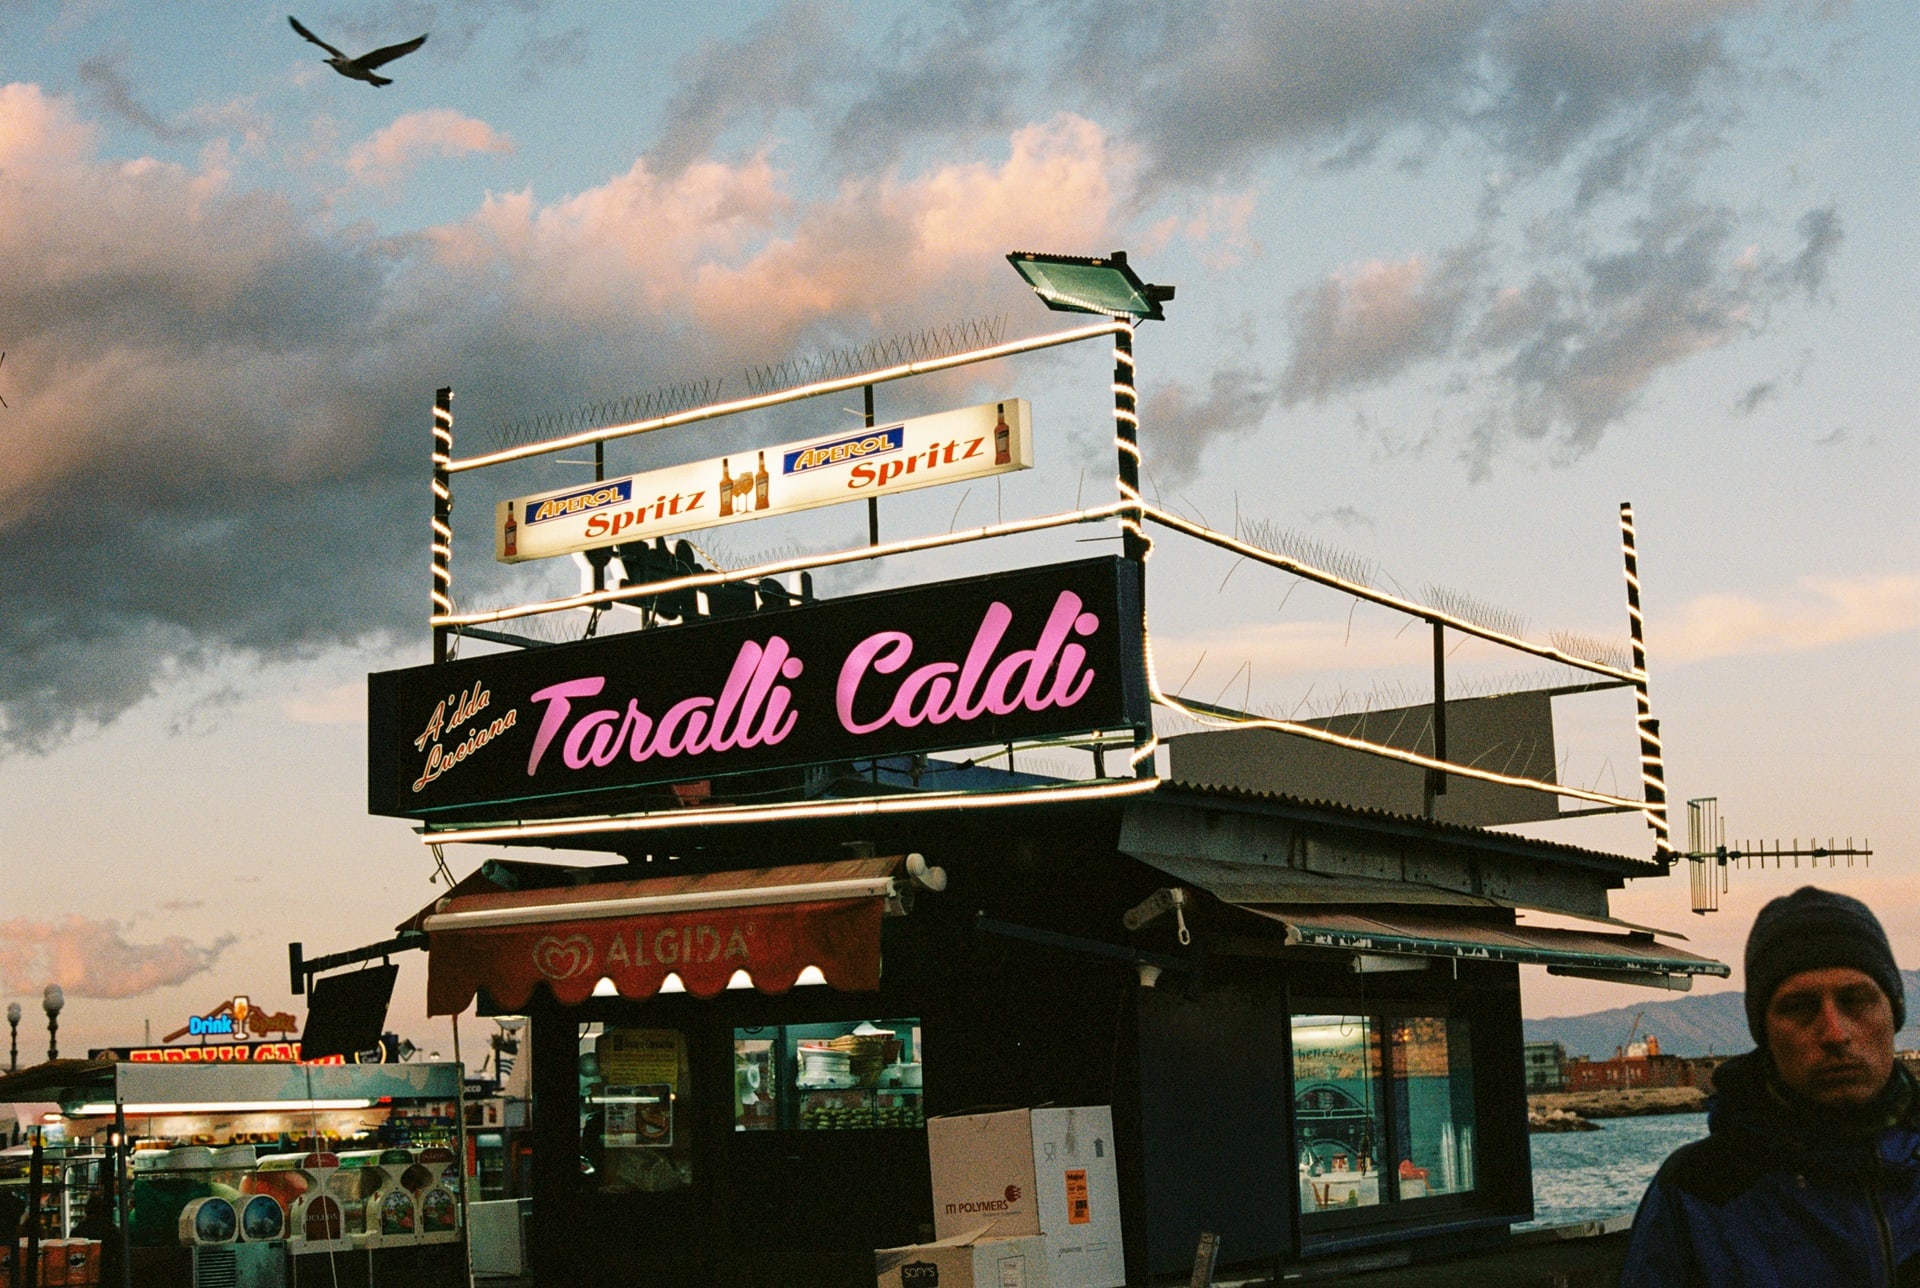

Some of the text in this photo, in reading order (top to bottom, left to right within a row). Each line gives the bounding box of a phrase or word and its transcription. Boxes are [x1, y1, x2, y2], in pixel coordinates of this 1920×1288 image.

[793, 434, 895, 472] APEROL
[846, 435, 986, 491] Spritz
[533, 486, 625, 526] APEROL
[584, 489, 706, 539] Spritz
[527, 589, 1100, 778] Taralli Caldi
[413, 679, 491, 752] A'dda
[411, 708, 518, 792] Luciana
[607, 924, 749, 967] ALGIDA
[188, 1013, 234, 1036] Drink
[958, 1199, 1009, 1214] POLYMERS
